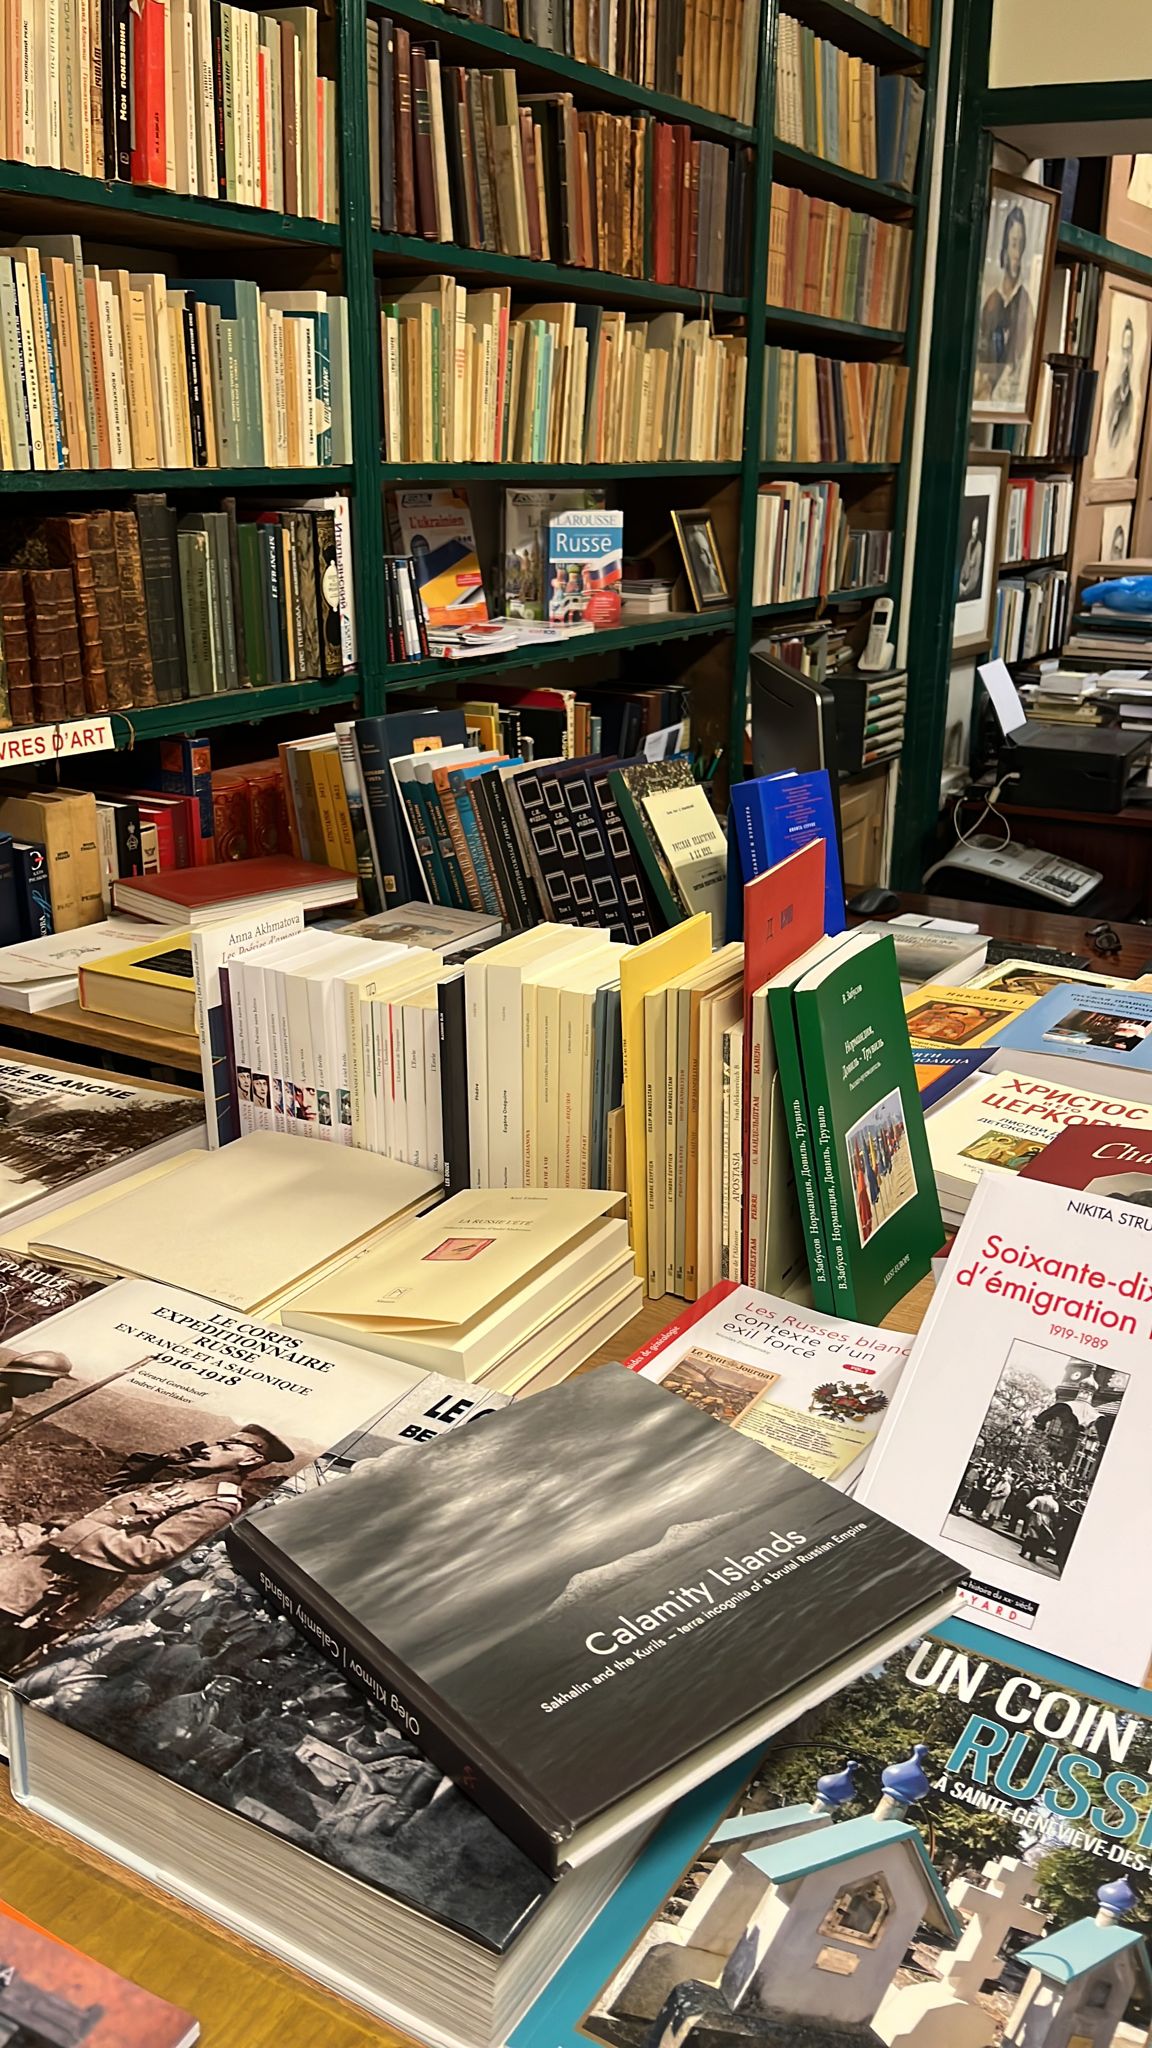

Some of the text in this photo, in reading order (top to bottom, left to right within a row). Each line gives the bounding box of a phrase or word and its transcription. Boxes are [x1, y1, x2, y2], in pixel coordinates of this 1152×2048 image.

[409, 514, 465, 529] L'ukrainien
[556, 514, 617, 526] LAROUSSE
[556, 533, 612, 553] Russe
[52, 727, 105, 749] D'ART
[228, 914, 300, 945] Anna Akhmatova
[27, 1074, 136, 1099] BLANCHE
[752, 1043, 761, 1155] МАНДЕЛЬШТАМ КАМЕНЬ
[1001, 1079, 1149, 1121] ХРИСТОС
[732, 1108, 740, 1121] Ivan
[977, 1118, 1039, 1137] ДЕТСКОГО
[999, 1118, 1049, 1135] ЛИСТКИ
[731, 1152, 741, 1202] APOSTASIA
[792, 1098, 826, 1283] В.Забусов Нормандия, Довиль, Трувиль
[816, 1105, 848, 1290] В.Забусов Нормандия, Довиль, Трувиль
[1067, 1200, 1113, 1222] NIKITA
[956, 1261, 1137, 1334] d'émigration
[207, 1313, 303, 1349] LE CORPS
[733, 1311, 822, 1347] contexte
[827, 1340, 876, 1363] d'un
[744, 1301, 776, 1319] Les
[781, 1315, 849, 1344] Russes
[1049, 1323, 1109, 1350] 1919-1989
[151, 1306, 336, 1374] EXPEDITIONNAIRE
[193, 1335, 261, 1365] RUSSE
[641, 1324, 679, 1357] de généalogie
[722, 1321, 758, 1340] exil
[762, 1334, 817, 1360] forcé
[113, 1322, 135, 1334] EN
[134, 1327, 195, 1357] FRANCE
[192, 1349, 210, 1363] ET
[223, 1360, 313, 1398] SALONIQUE
[151, 1352, 242, 1387] 1916-1918
[690, 1347, 776, 1381] Le Petit Journal
[138, 1368, 208, 1398] Gérard Gorokhoff
[153, 1385, 194, 1404] Korliakov
[423, 1394, 475, 1425] LE
[584, 1528, 807, 1657] Calamity Islands
[968, 1580, 1035, 1613] histoire du siècle
[540, 1520, 867, 1714] Sakhalin and the Kurils terra incognita of a brutal Russian Empire
[259, 1571, 420, 1736] Oleg Klimov Calamity Islands
[904, 1640, 1138, 1764] UN COIN
[932, 1772, 948, 1793] À
